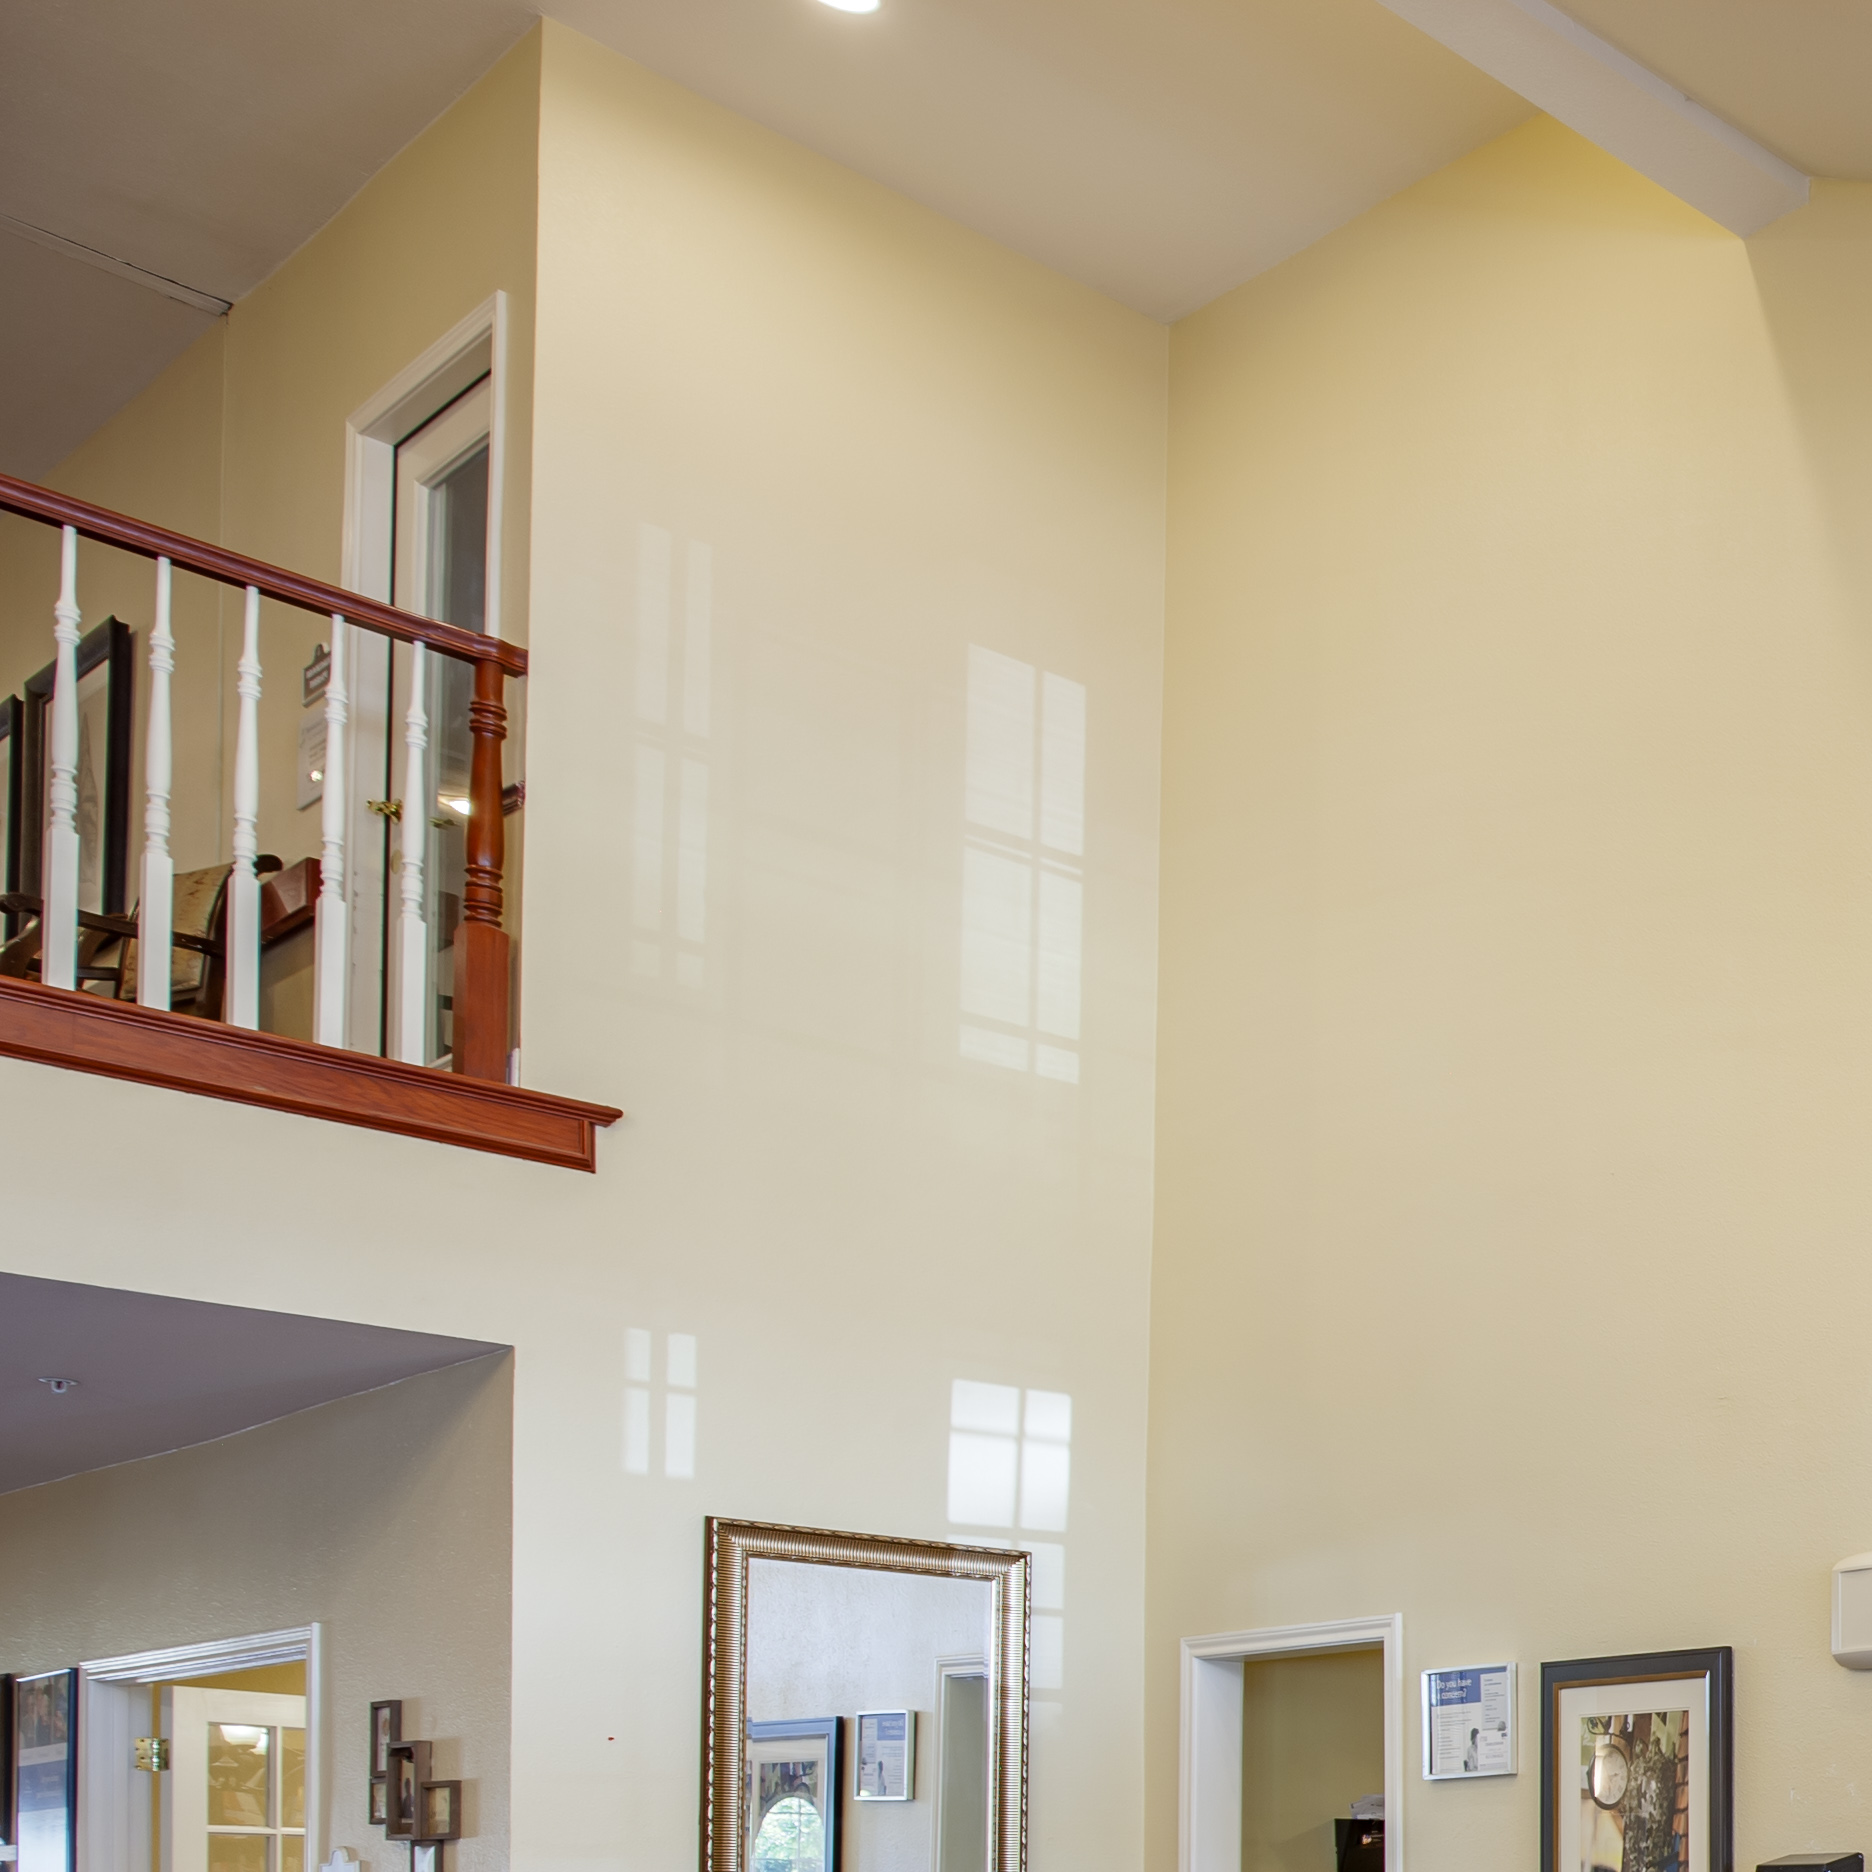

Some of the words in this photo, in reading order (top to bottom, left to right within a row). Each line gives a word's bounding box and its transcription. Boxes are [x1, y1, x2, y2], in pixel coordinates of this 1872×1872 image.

[1446, 1681, 1456, 1690] you
[1457, 1678, 1472, 1687] have
[1441, 1688, 1467, 1699] concern?
